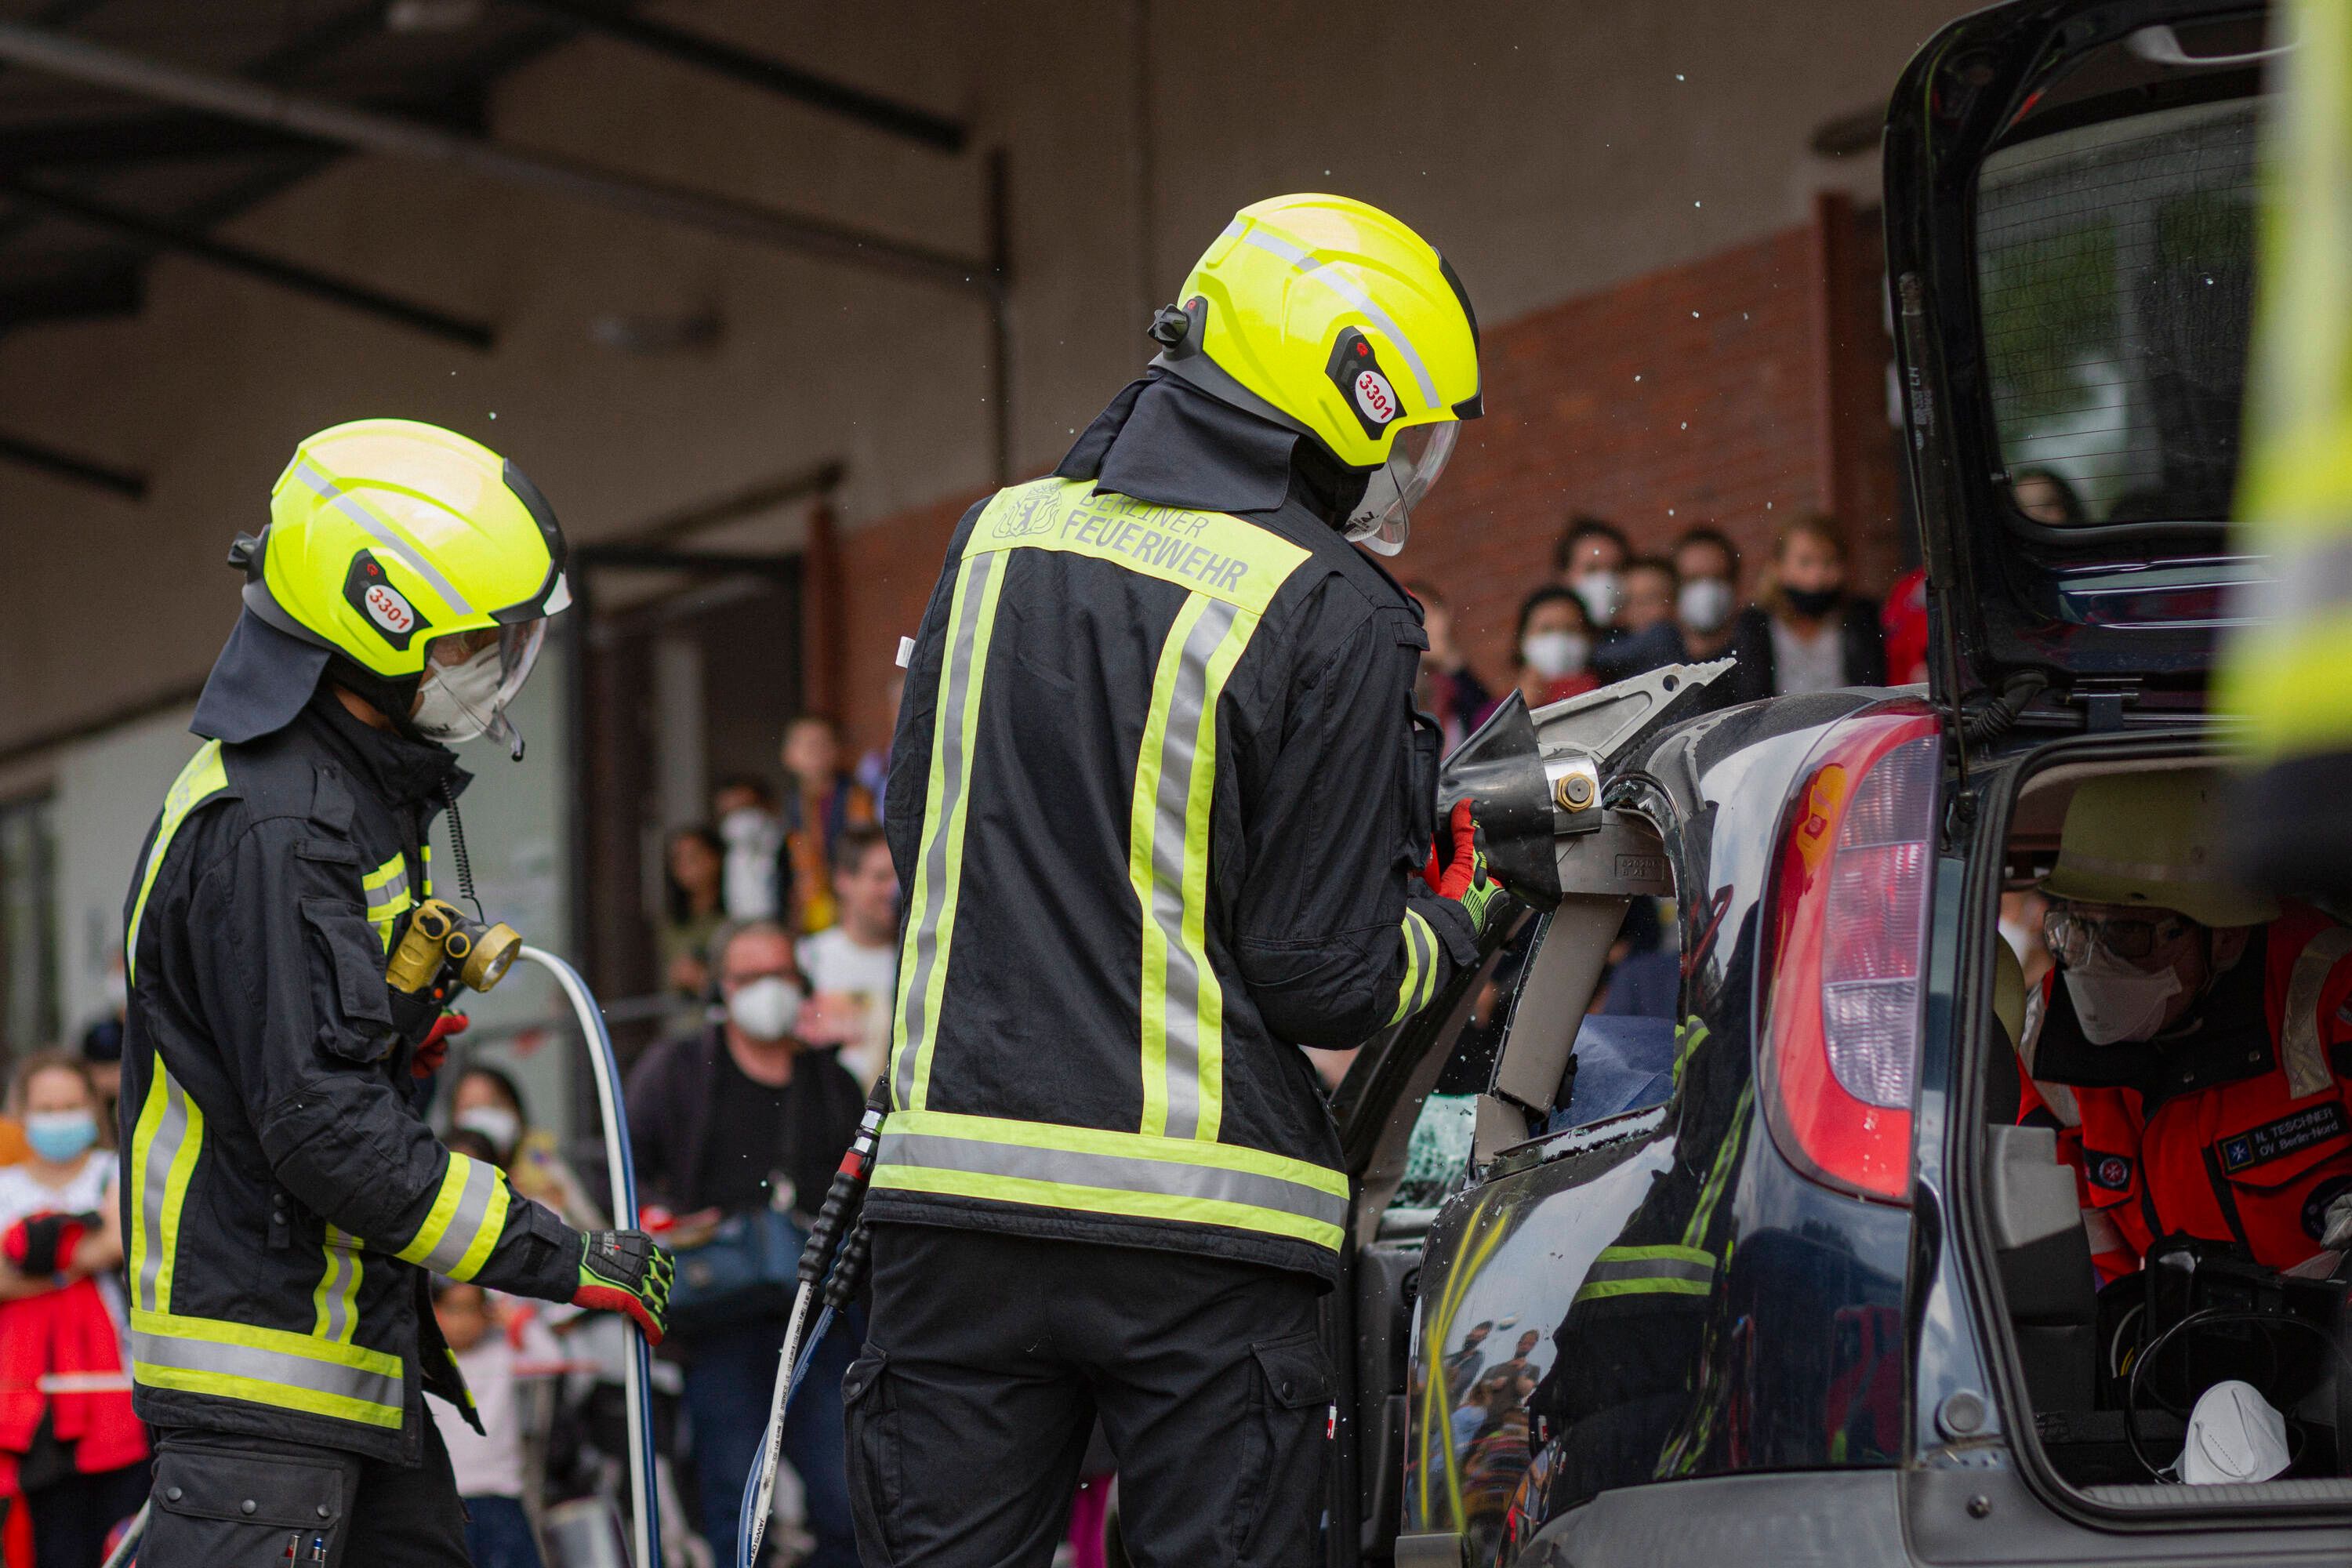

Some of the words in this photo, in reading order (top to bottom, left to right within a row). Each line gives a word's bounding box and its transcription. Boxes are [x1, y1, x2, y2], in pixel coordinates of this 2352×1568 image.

[1359, 374, 1393, 419] 3301
[1079, 489, 1209, 539] BERLINER
[1060, 509, 1249, 593] FEUERWEHR
[369, 588, 410, 630] 3301
[603, 1232, 615, 1256] SEIZ
[754, 1518, 764, 1544] JAWS
